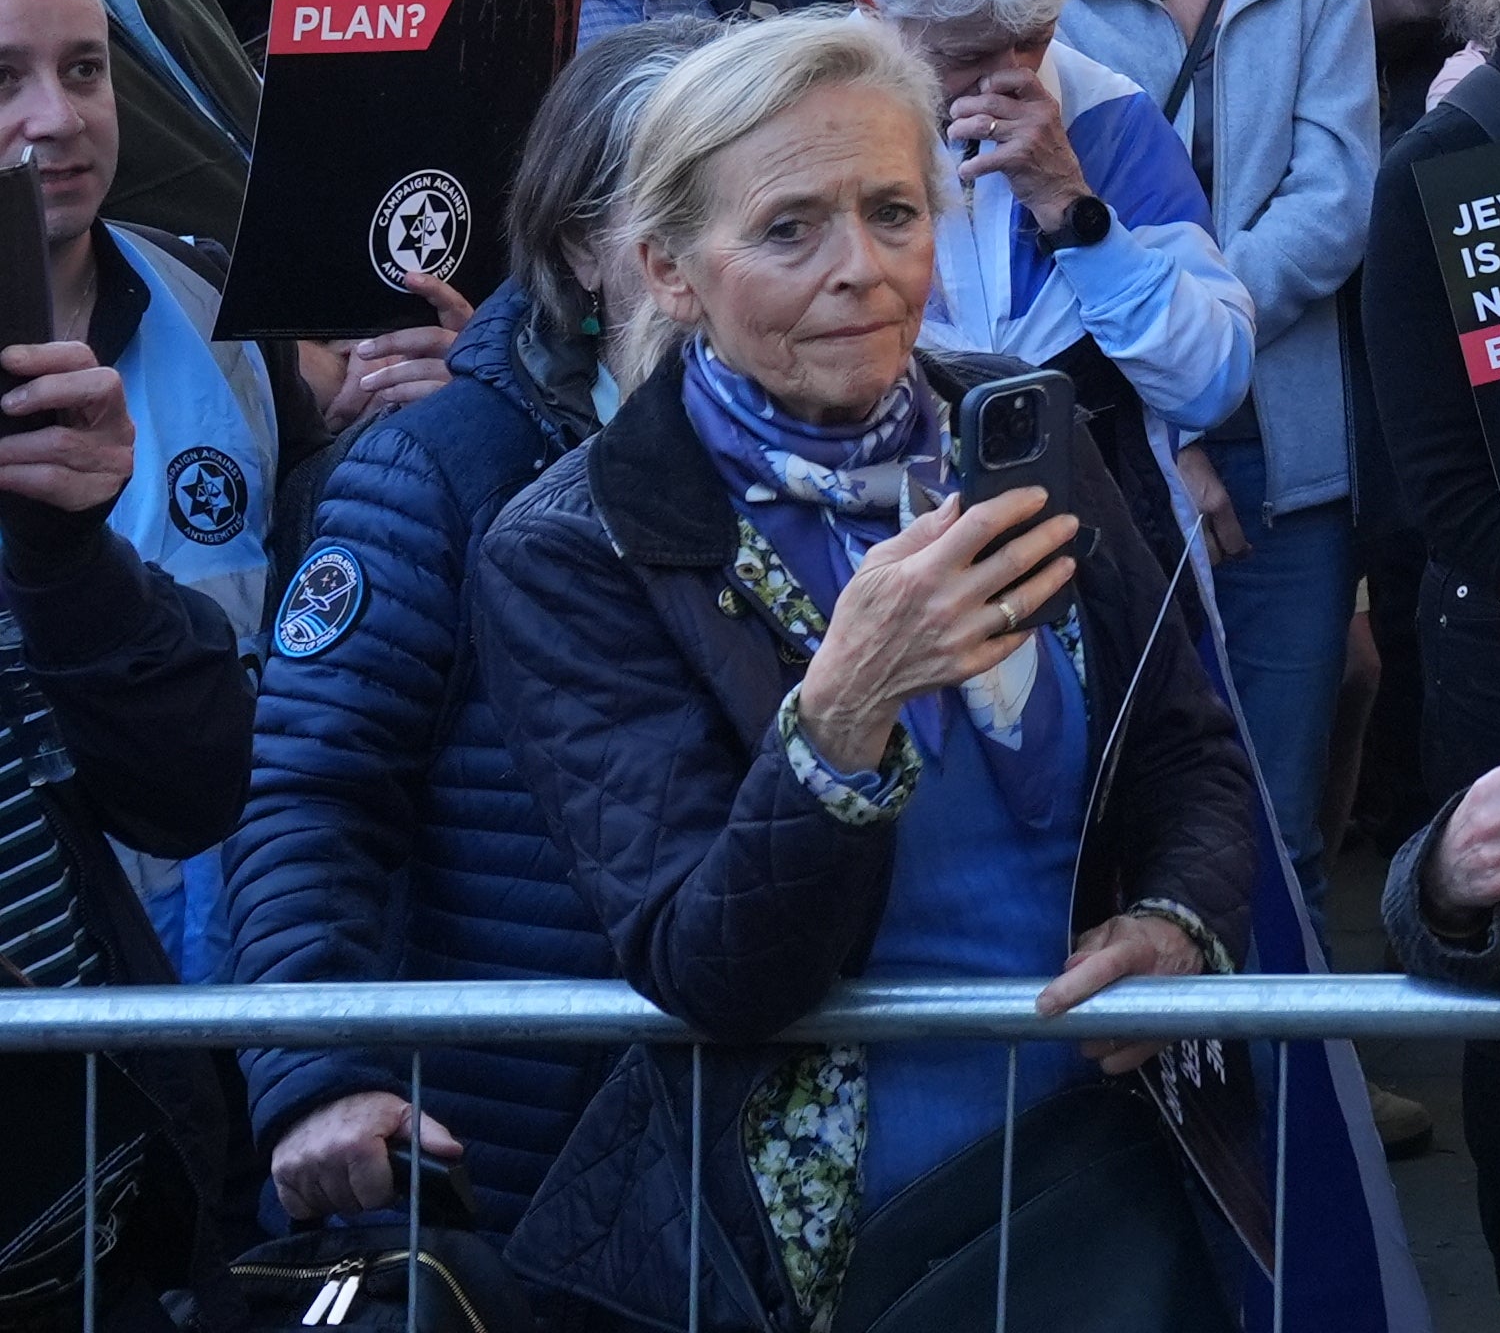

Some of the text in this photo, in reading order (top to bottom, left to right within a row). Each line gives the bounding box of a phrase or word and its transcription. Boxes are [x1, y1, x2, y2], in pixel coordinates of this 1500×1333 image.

[292, 4, 427, 43] PLAN?
[378, 176, 466, 227] CAMPAIGN AGAINST
[381, 256, 456, 286] ANTTISM
